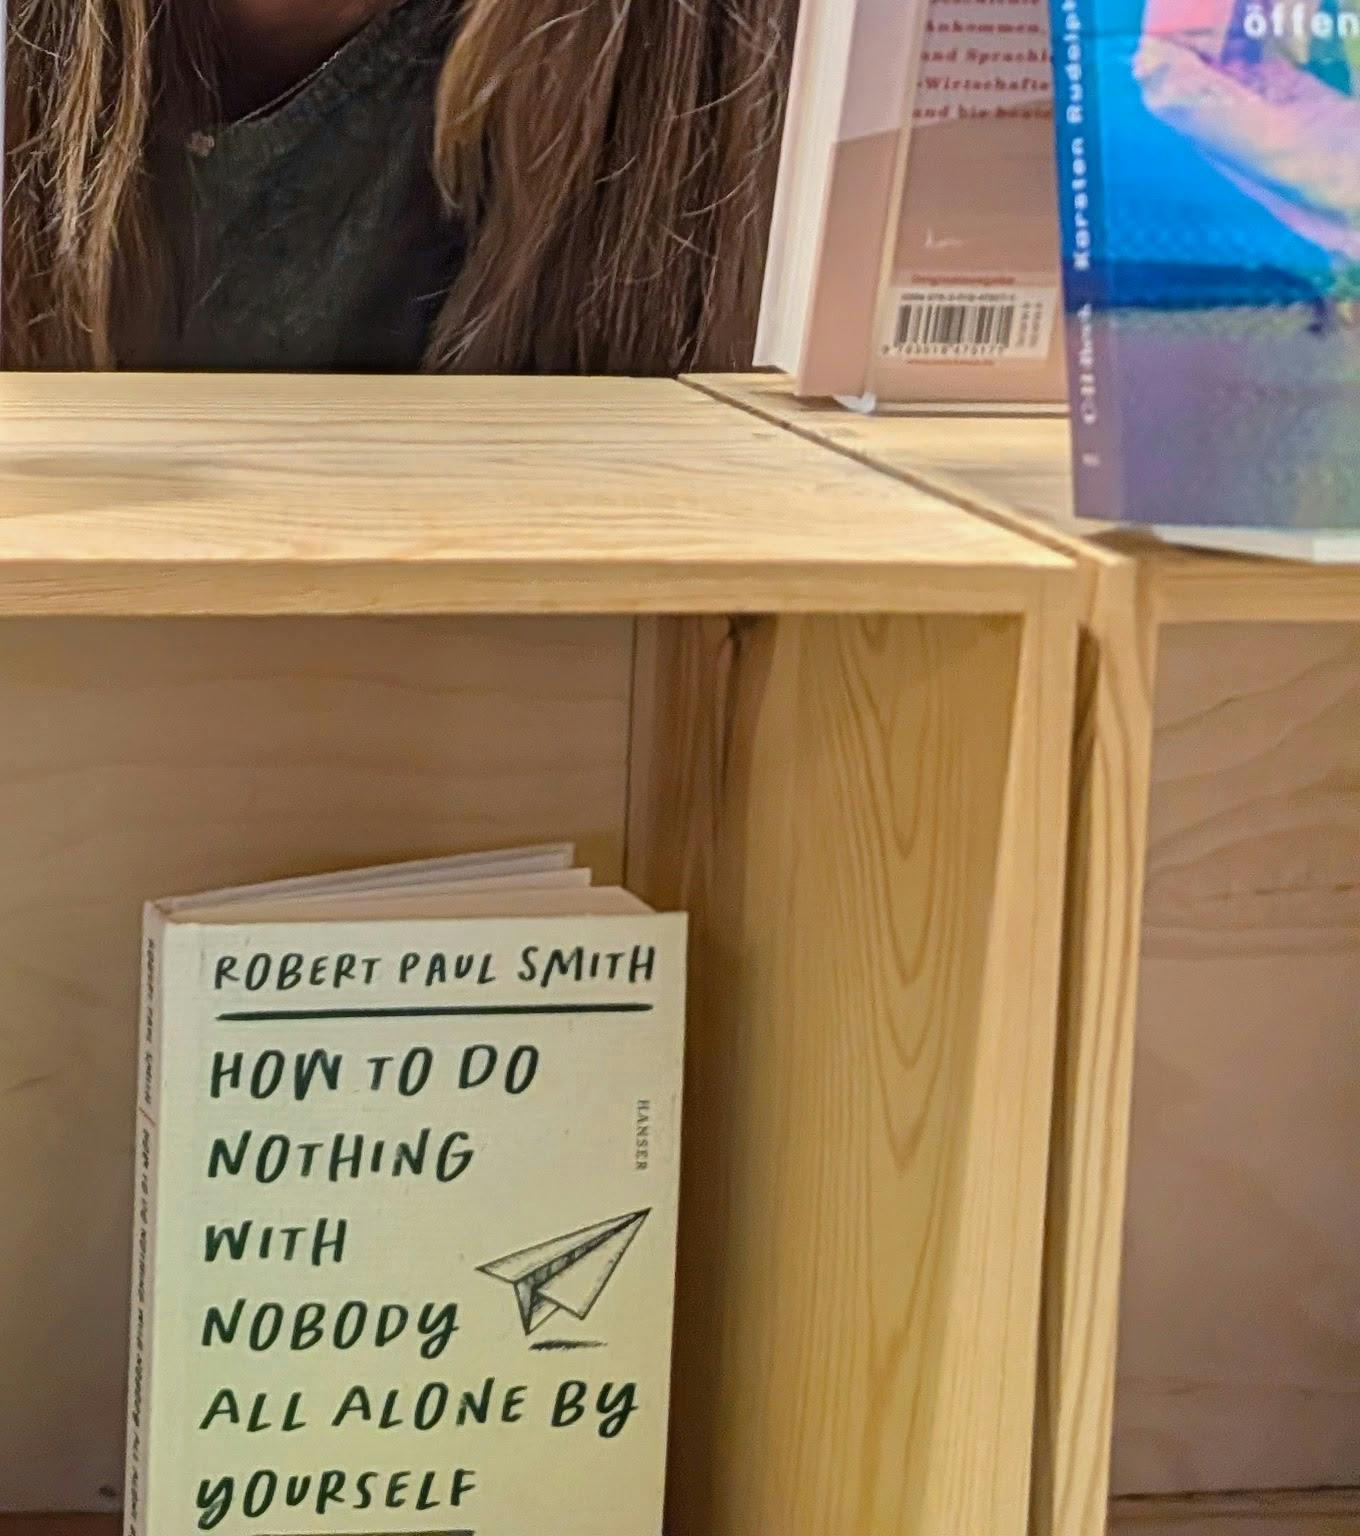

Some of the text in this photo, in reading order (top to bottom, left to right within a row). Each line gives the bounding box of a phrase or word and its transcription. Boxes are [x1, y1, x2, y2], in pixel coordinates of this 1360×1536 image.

[1068, 137, 1091, 271] Karsten
[214, 944, 657, 996] ROBERT PAUL SMITH
[211, 1044, 540, 1101] HOW TO DO
[208, 1128, 475, 1184] NOTHING
[634, 1098, 649, 1173] HANSER
[205, 1217, 348, 1267] WITH
[202, 1297, 460, 1360] NOBODY
[199, 1376, 641, 1440] ALL ALONE BY
[196, 1468, 476, 1531] YOURSELF
